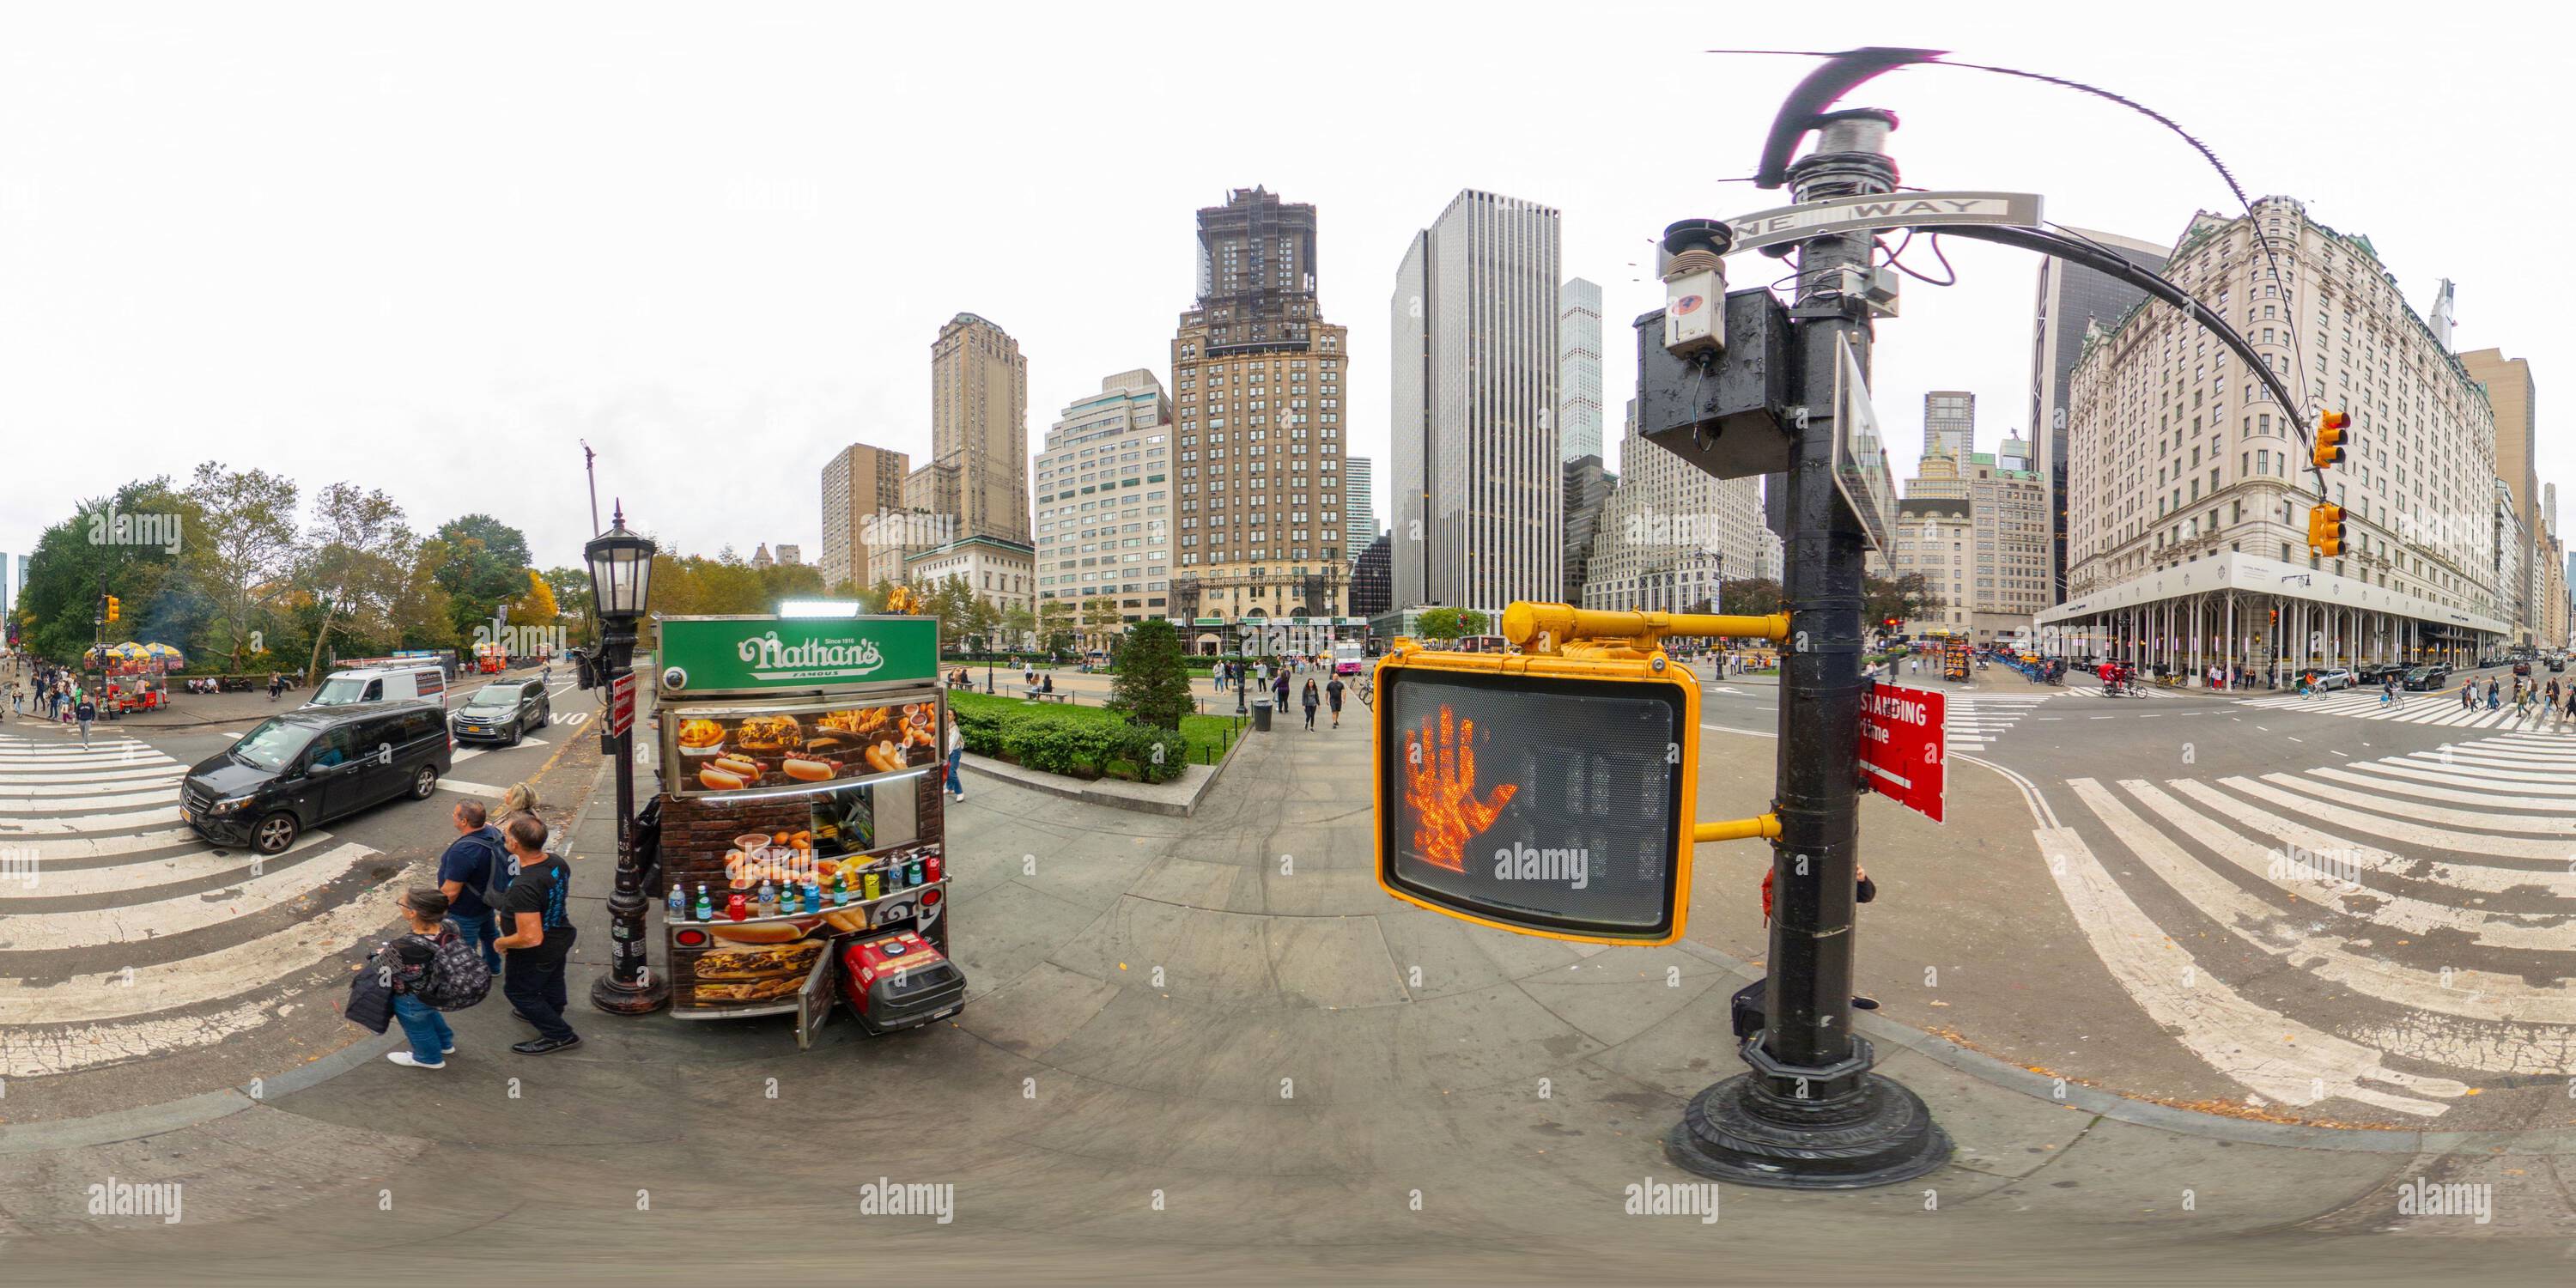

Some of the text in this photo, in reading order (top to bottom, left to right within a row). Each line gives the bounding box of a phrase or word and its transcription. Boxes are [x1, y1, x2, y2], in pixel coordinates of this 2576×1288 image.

[1733, 200, 1982, 241] NE WAY
[737, 636, 884, 669] Nathan's
[549, 712, 589, 726] NO
[1861, 692, 1927, 726] STANDING
[1860, 718, 1890, 744] time
